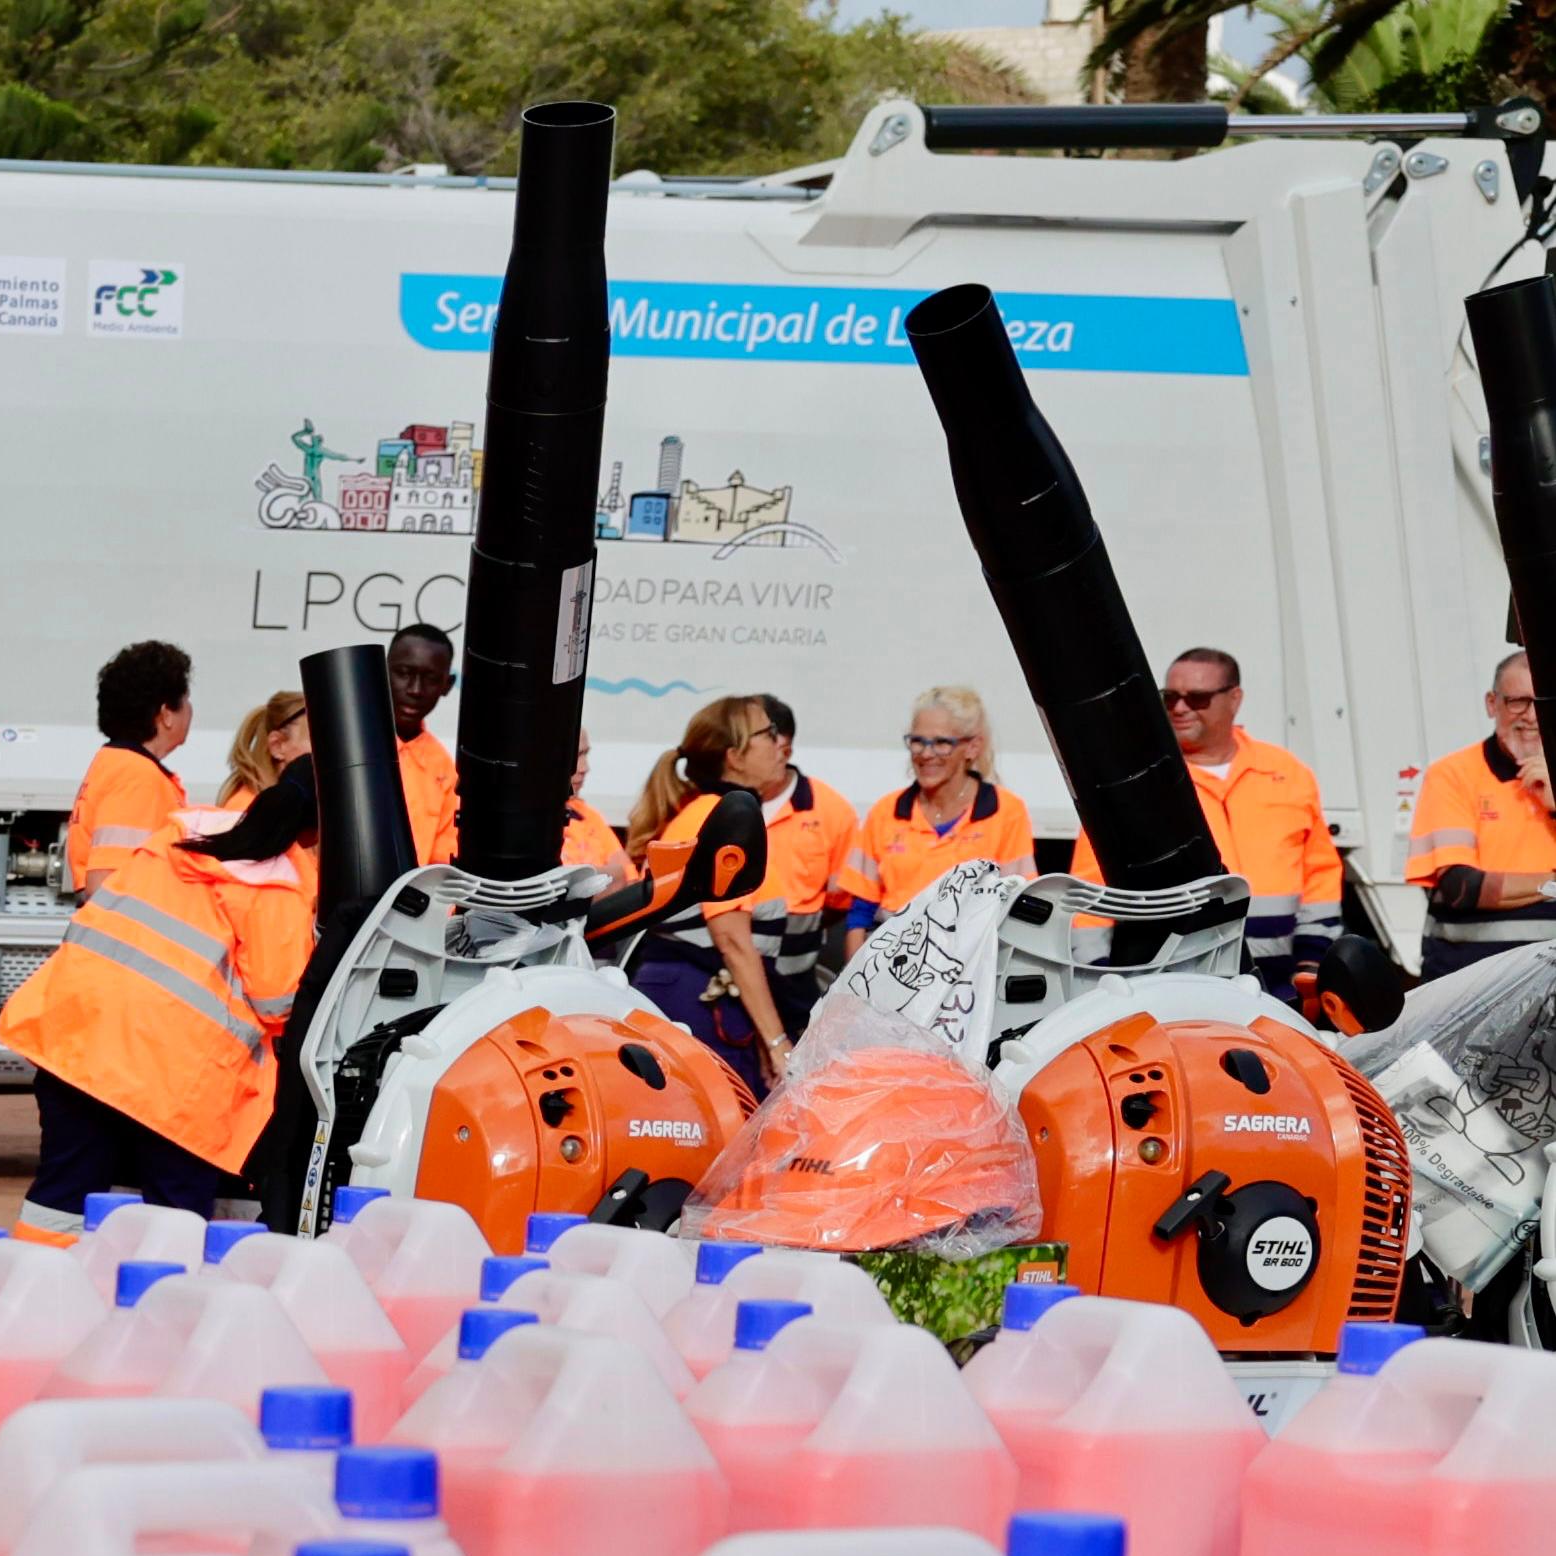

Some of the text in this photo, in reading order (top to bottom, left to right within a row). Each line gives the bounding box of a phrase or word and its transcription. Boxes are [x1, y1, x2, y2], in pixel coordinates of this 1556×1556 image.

[0, 293, 59, 310] Palmas
[93, 285, 161, 317] FCC
[92, 320, 179, 335] Medio Ambiente
[608, 295, 1075, 352] Municipal de Leza
[251, 569, 466, 634] LPGC
[594, 577, 834, 610] DAD PARA VIVIR
[631, 623, 659, 643] DE
[664, 624, 726, 644] GRAN
[732, 625, 828, 646] CANARIA
[628, 1119, 703, 1140] SAGRERA
[1223, 1114, 1311, 1134] SAGRERA
[789, 1158, 835, 1175] TIHL
[1251, 1240, 1307, 1255] STIHL
[1262, 1257, 1304, 1267] BR 600
[1022, 1270, 1054, 1283] STIHL
